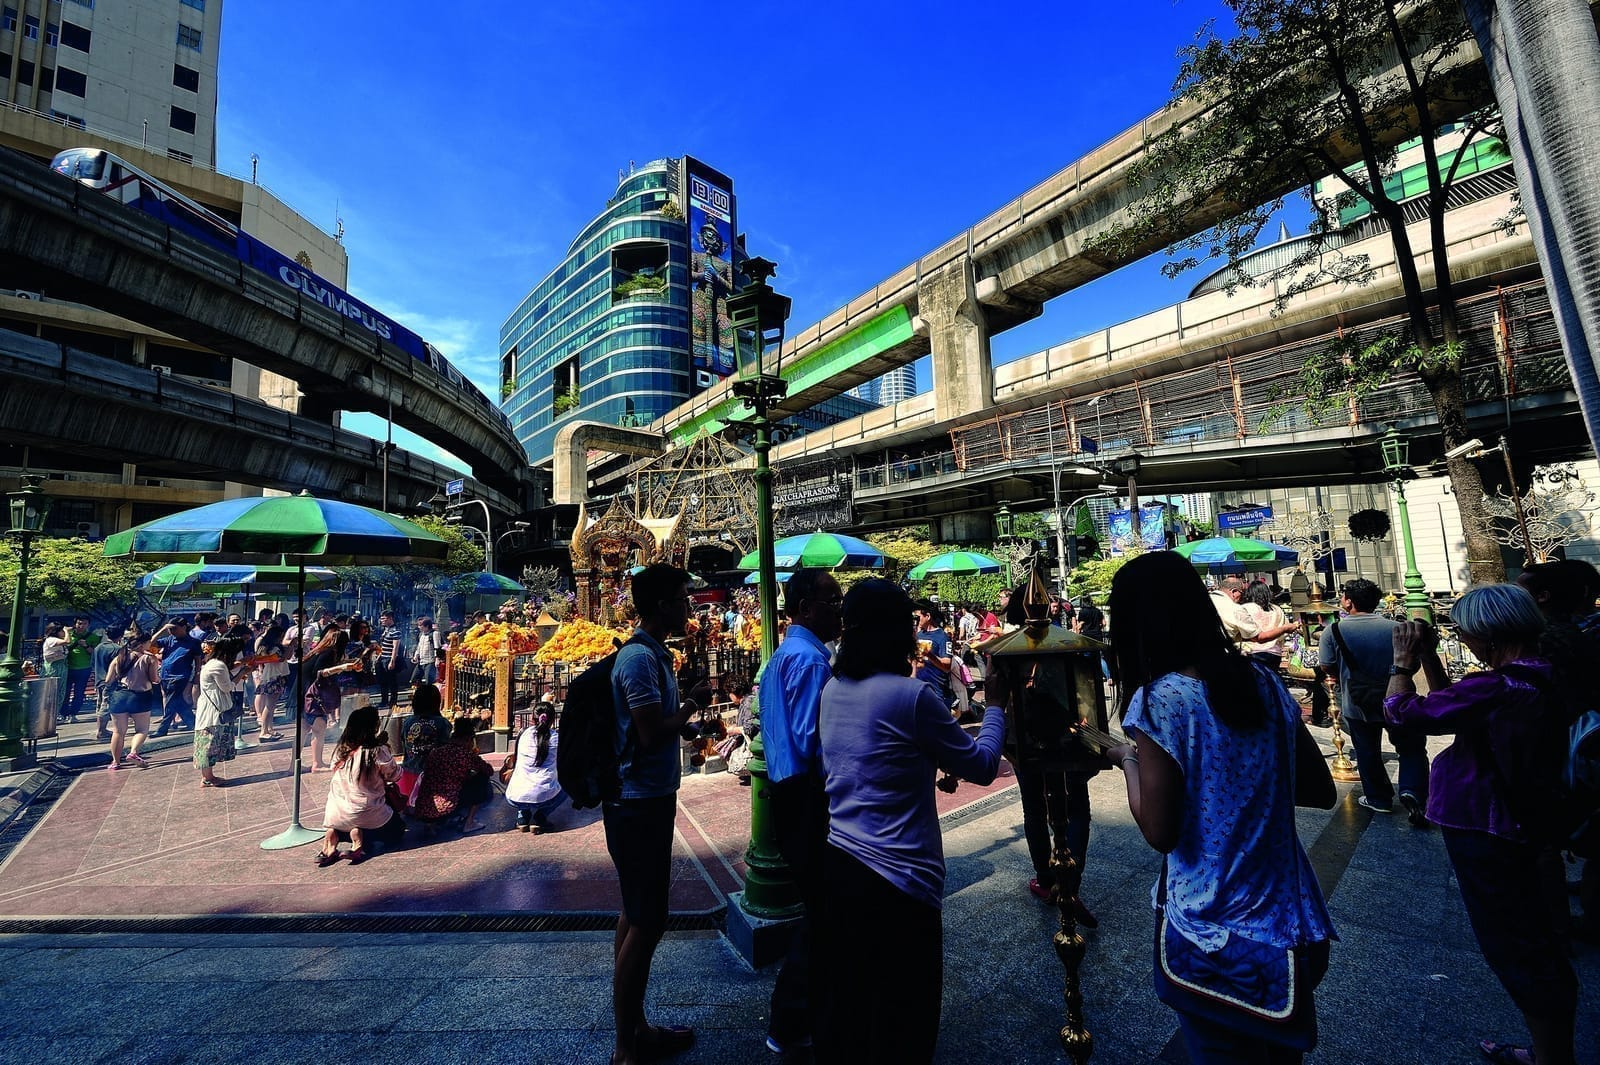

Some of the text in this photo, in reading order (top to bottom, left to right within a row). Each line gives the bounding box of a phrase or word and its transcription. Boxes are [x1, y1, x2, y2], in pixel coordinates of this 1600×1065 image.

[695, 182, 727, 209] 13:00
[280, 266, 392, 339] OLYMPUS
[774, 485, 840, 502] RATCHAPRASONG
